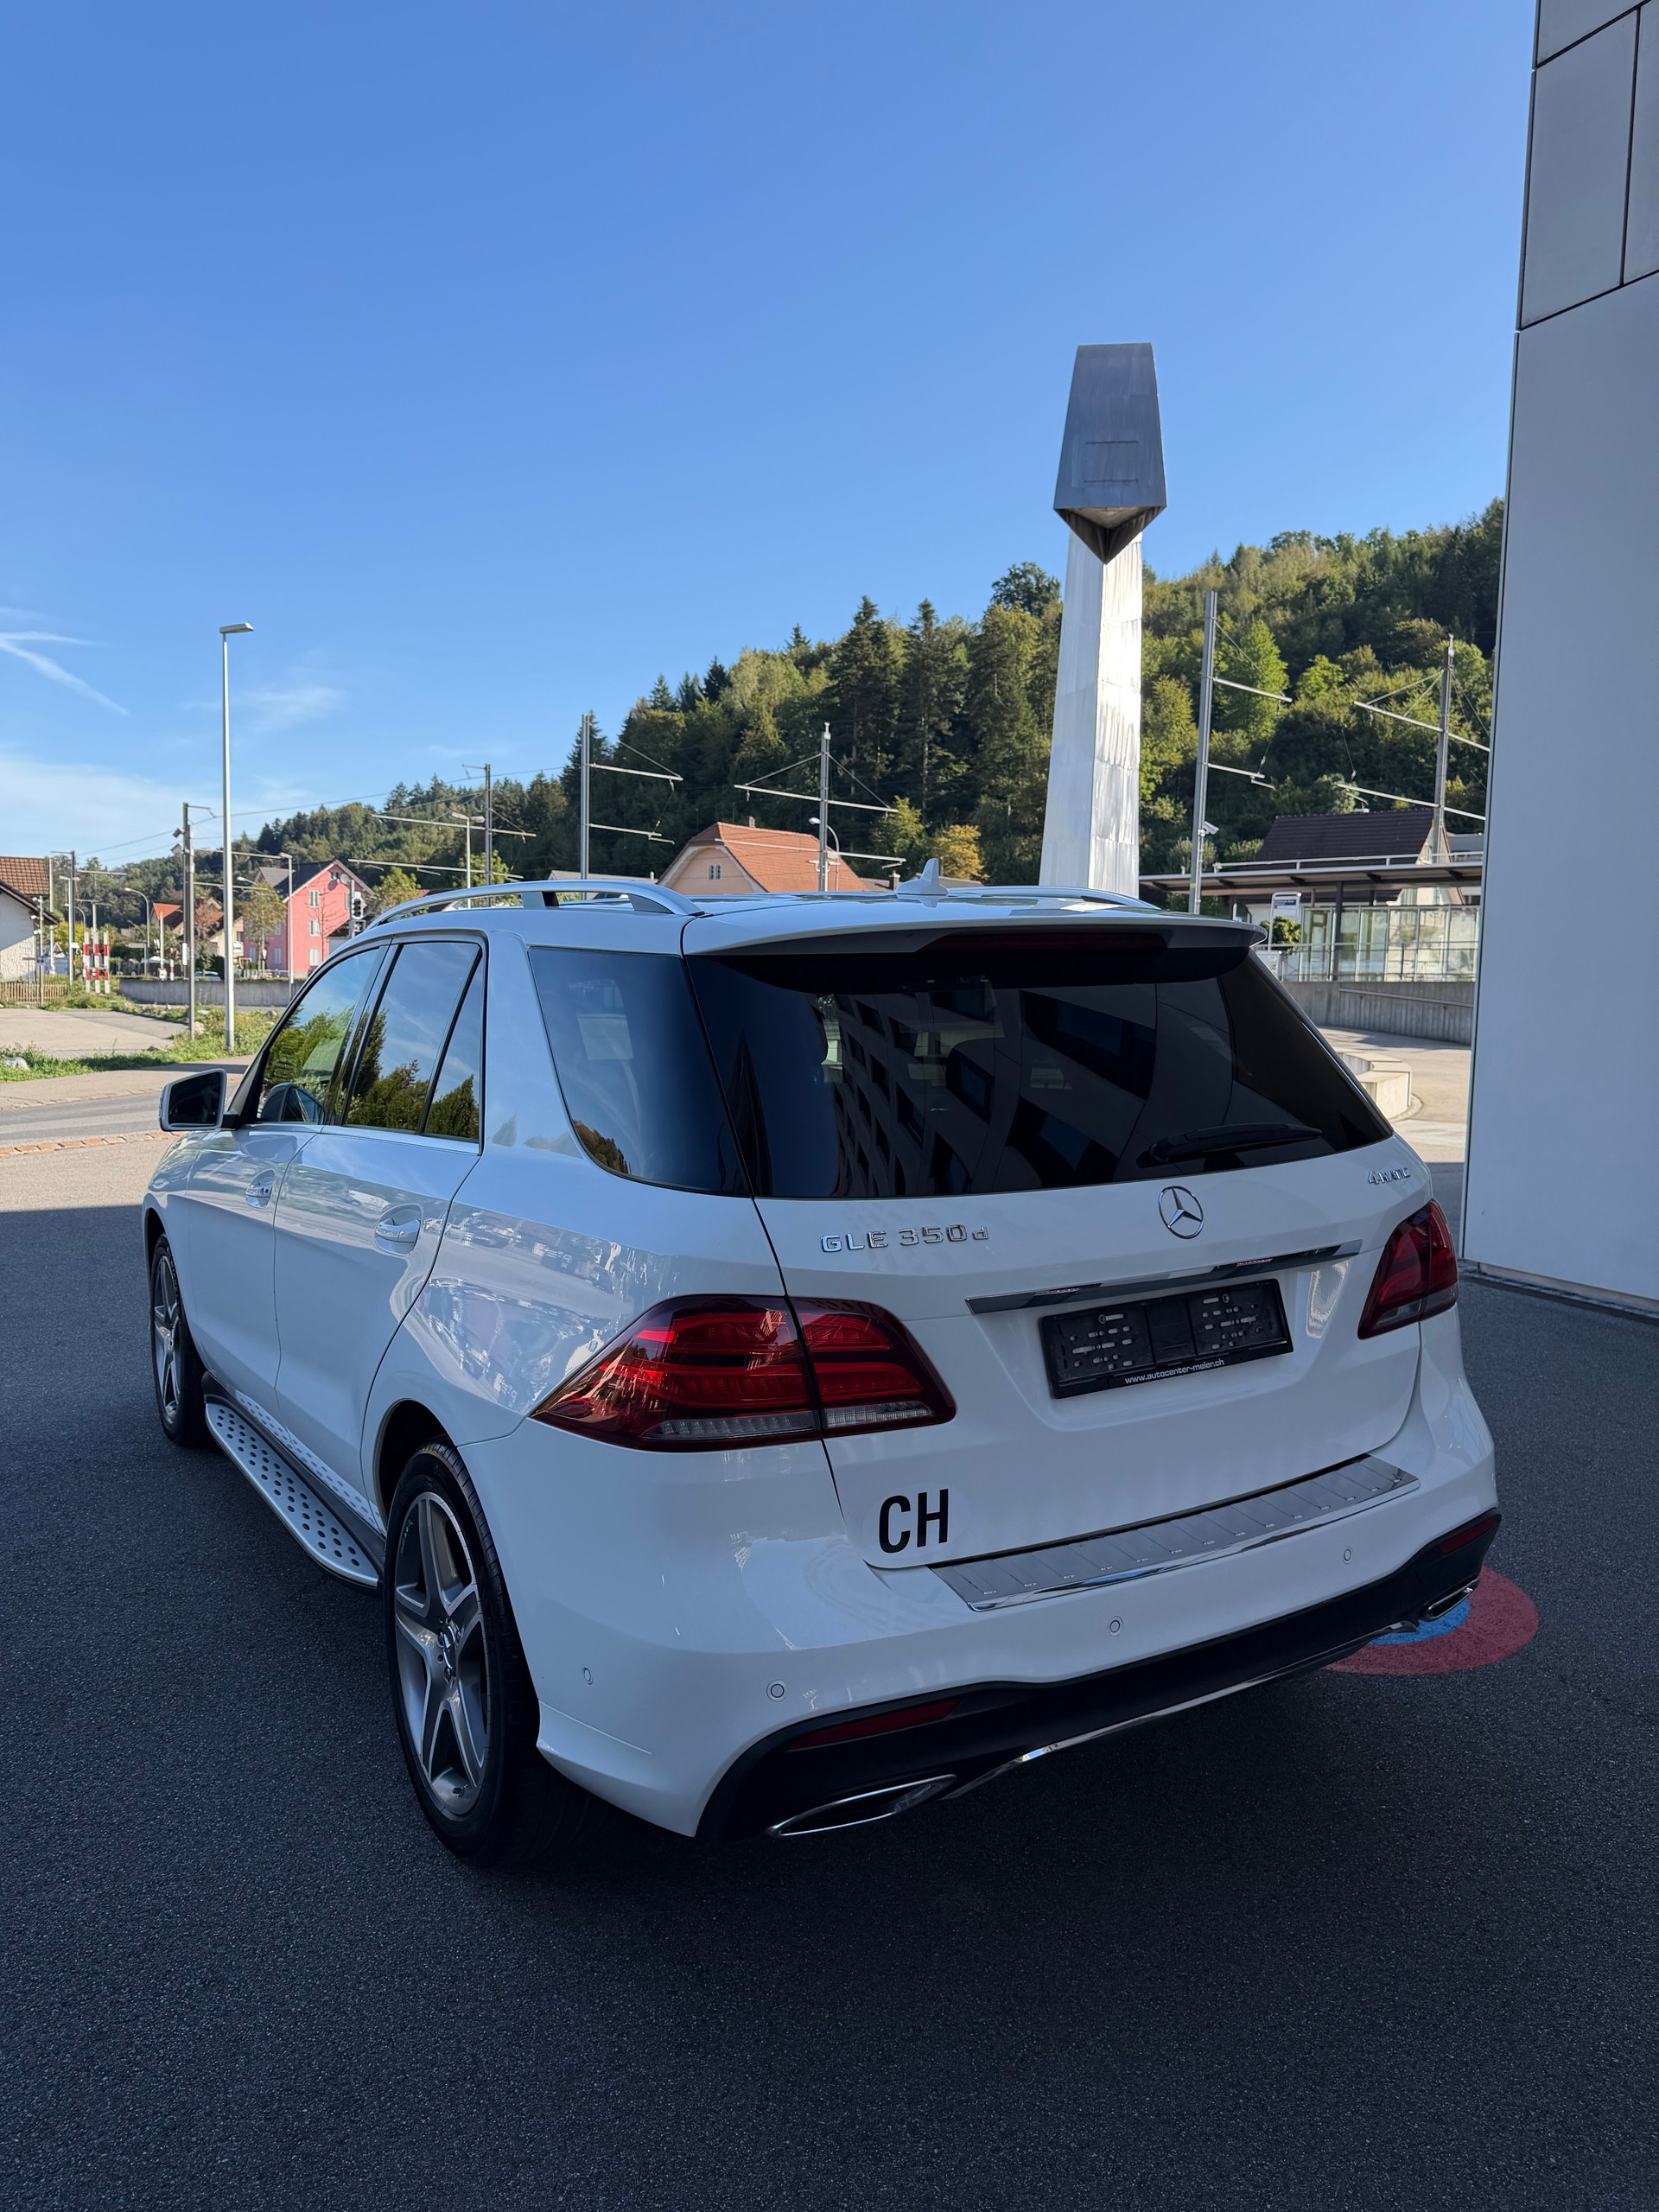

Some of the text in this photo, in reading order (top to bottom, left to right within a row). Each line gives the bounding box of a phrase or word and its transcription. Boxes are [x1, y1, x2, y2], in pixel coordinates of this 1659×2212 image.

[821, 1230, 889, 1253] GLE
[1124, 1358, 1225, 1384] www.autocenter-meier.ch
[879, 1488, 949, 1554] CH
